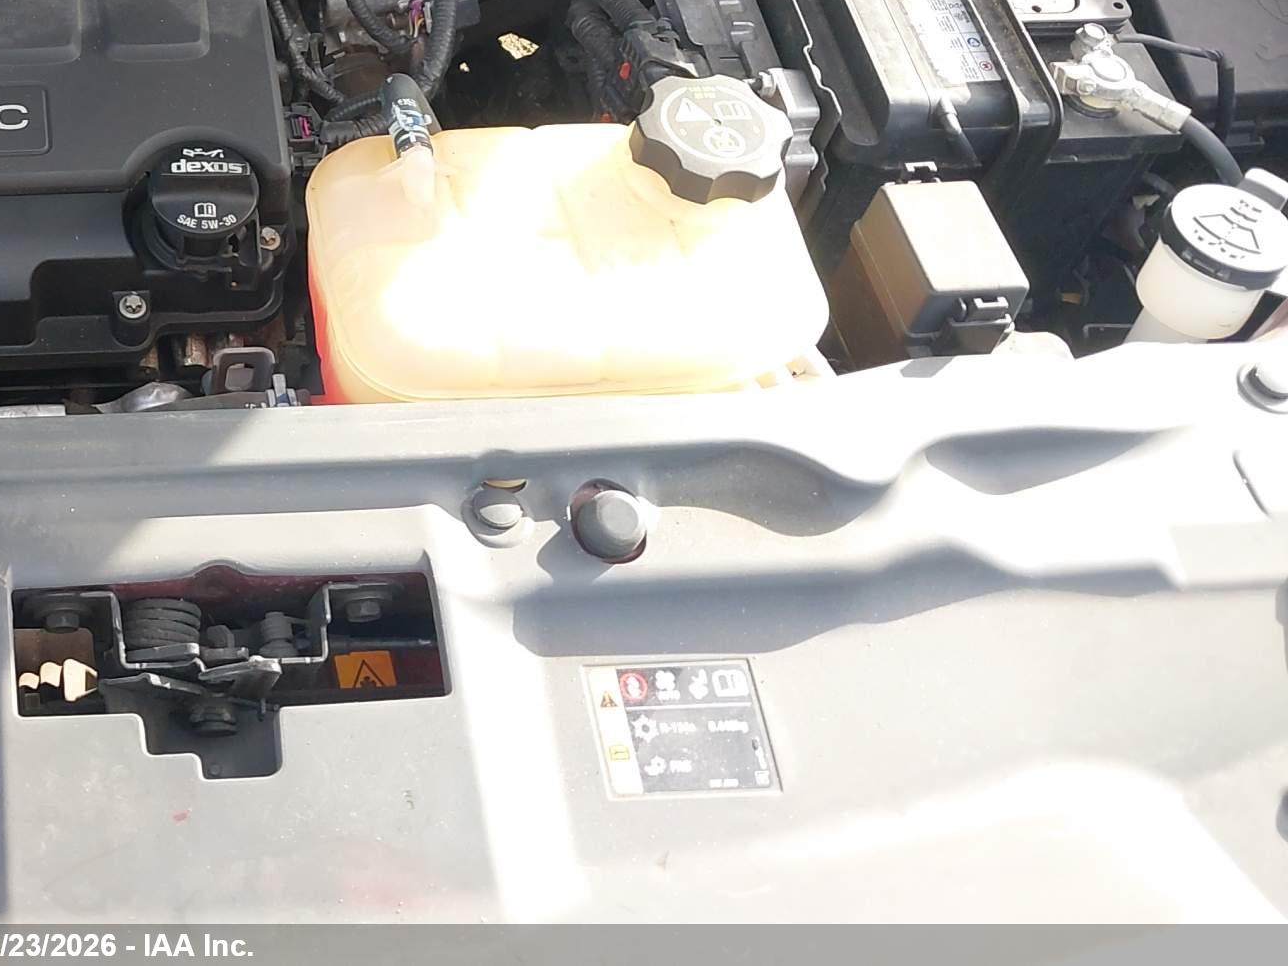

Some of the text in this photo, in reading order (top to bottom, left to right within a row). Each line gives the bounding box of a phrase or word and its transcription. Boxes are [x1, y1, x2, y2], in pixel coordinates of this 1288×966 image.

[171, 159, 243, 174] dexos
[177, 214, 237, 229] SAE 5W-30
